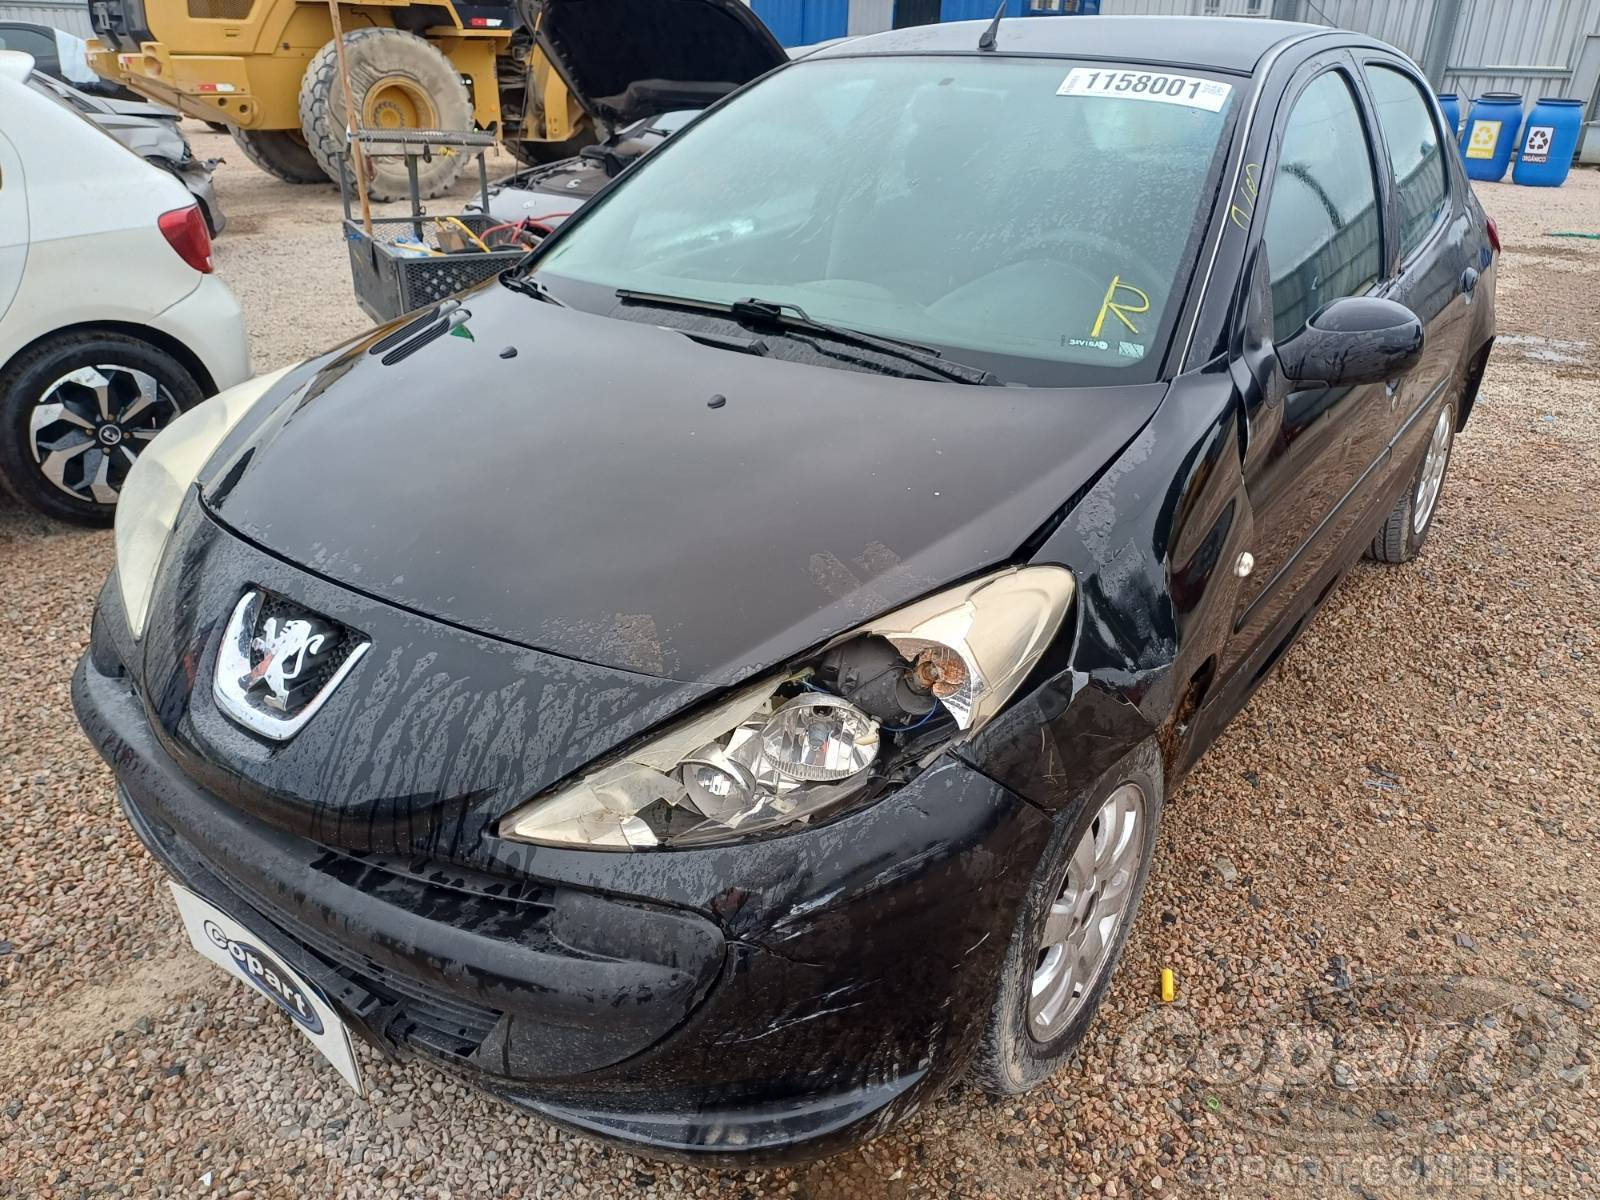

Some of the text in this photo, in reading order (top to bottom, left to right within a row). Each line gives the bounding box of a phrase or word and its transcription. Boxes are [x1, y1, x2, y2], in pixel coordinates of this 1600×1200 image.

[1086, 71, 1202, 100] 1158001
[1091, 275, 1150, 335] R
[203, 918, 307, 1017] Copart
